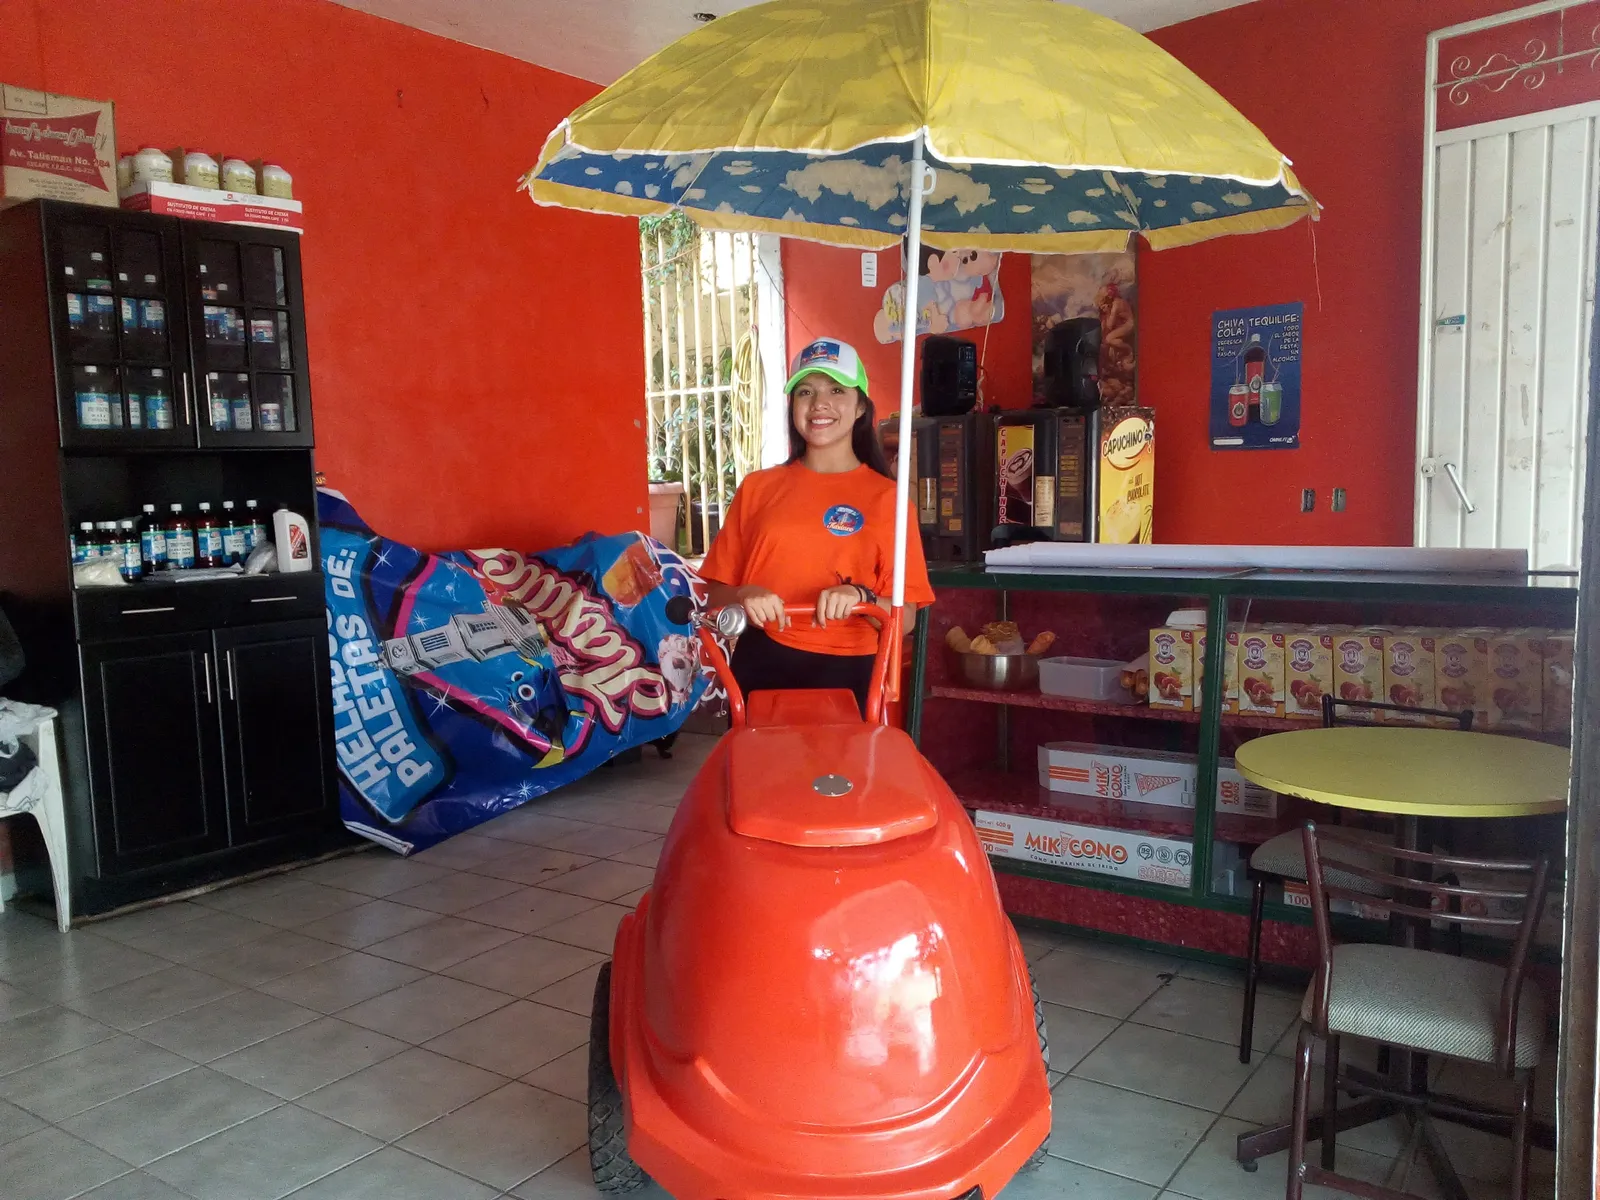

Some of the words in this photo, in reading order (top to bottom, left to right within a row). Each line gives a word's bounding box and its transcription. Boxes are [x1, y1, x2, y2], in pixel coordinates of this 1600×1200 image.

[1217, 318, 1244, 329] CHIVA
[1248, 313, 1299, 327] TEQUILIFE:
[1217, 327, 1245, 338] COLA:
[326, 547, 358, 600] DE:
[335, 612, 434, 788] PALETAS
[1111, 764, 1124, 798] CONO
[1220, 781, 1233, 805] 100
[982, 843, 994, 852] 00
[1289, 895, 1309, 906] 100
